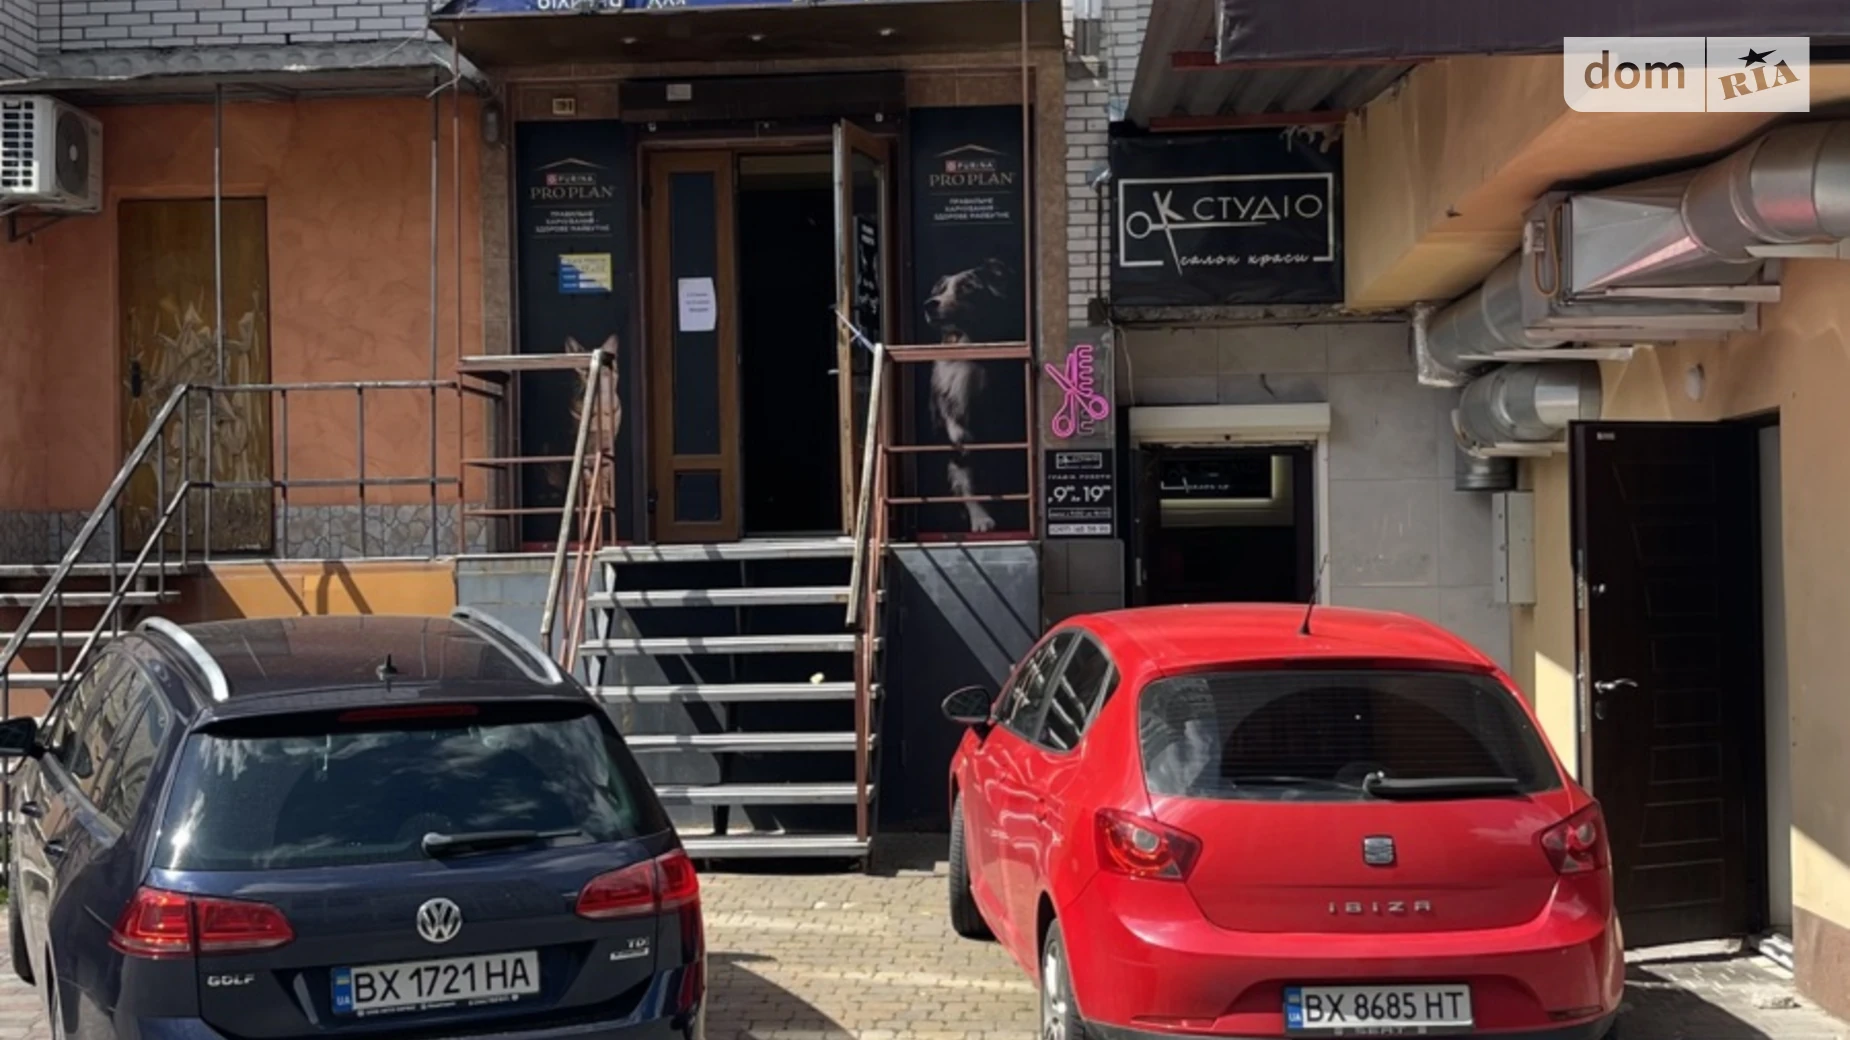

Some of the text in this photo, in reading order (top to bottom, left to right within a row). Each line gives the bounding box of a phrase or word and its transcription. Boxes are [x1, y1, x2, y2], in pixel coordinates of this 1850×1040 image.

[929, 171, 1013, 187] PRO PLAN
[530, 184, 614, 200] PRO PLAN
[1192, 193, 1323, 221] СТУДІО
[1178, 252, 1310, 268] салон краси
[1328, 900, 1432, 914] IBIZA
[206, 973, 256, 988] GOLF
[355, 957, 530, 1004] BX 1721 HA
[336, 995, 351, 1006] UA
[1305, 991, 1464, 1022] BX 8685 HT
[1288, 1013, 1301, 1022] UA
